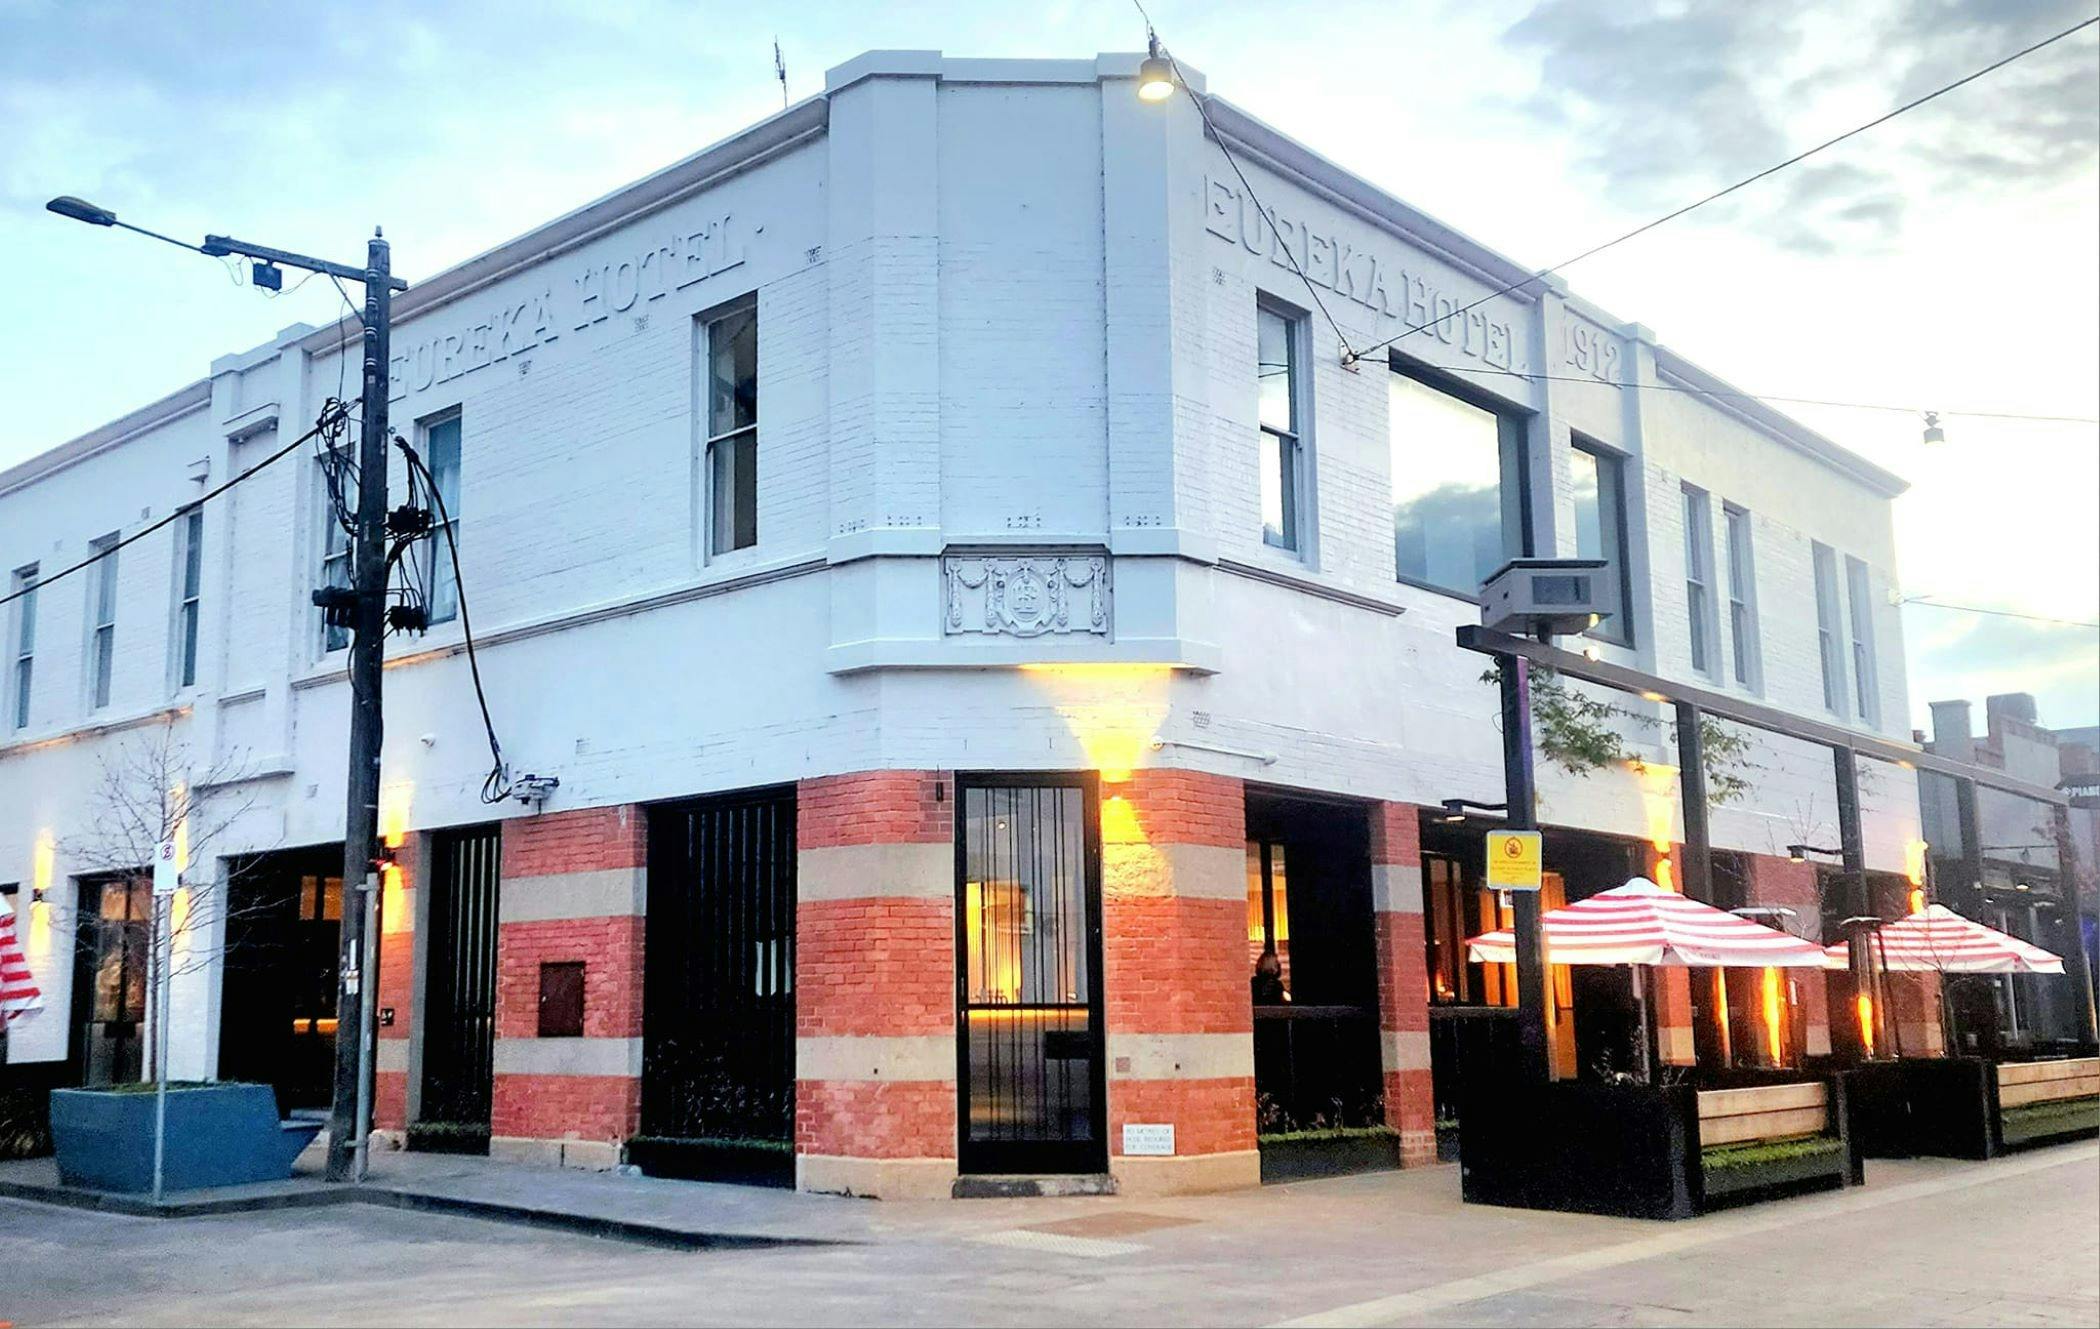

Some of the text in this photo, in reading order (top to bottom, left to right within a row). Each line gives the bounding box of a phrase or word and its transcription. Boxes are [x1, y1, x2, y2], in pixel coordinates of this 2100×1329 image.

[387, 213, 746, 404] EUREKA HOTEL
[1203, 175, 1532, 382] EUREKA HOTEL
[1563, 316, 1623, 388] 1912
